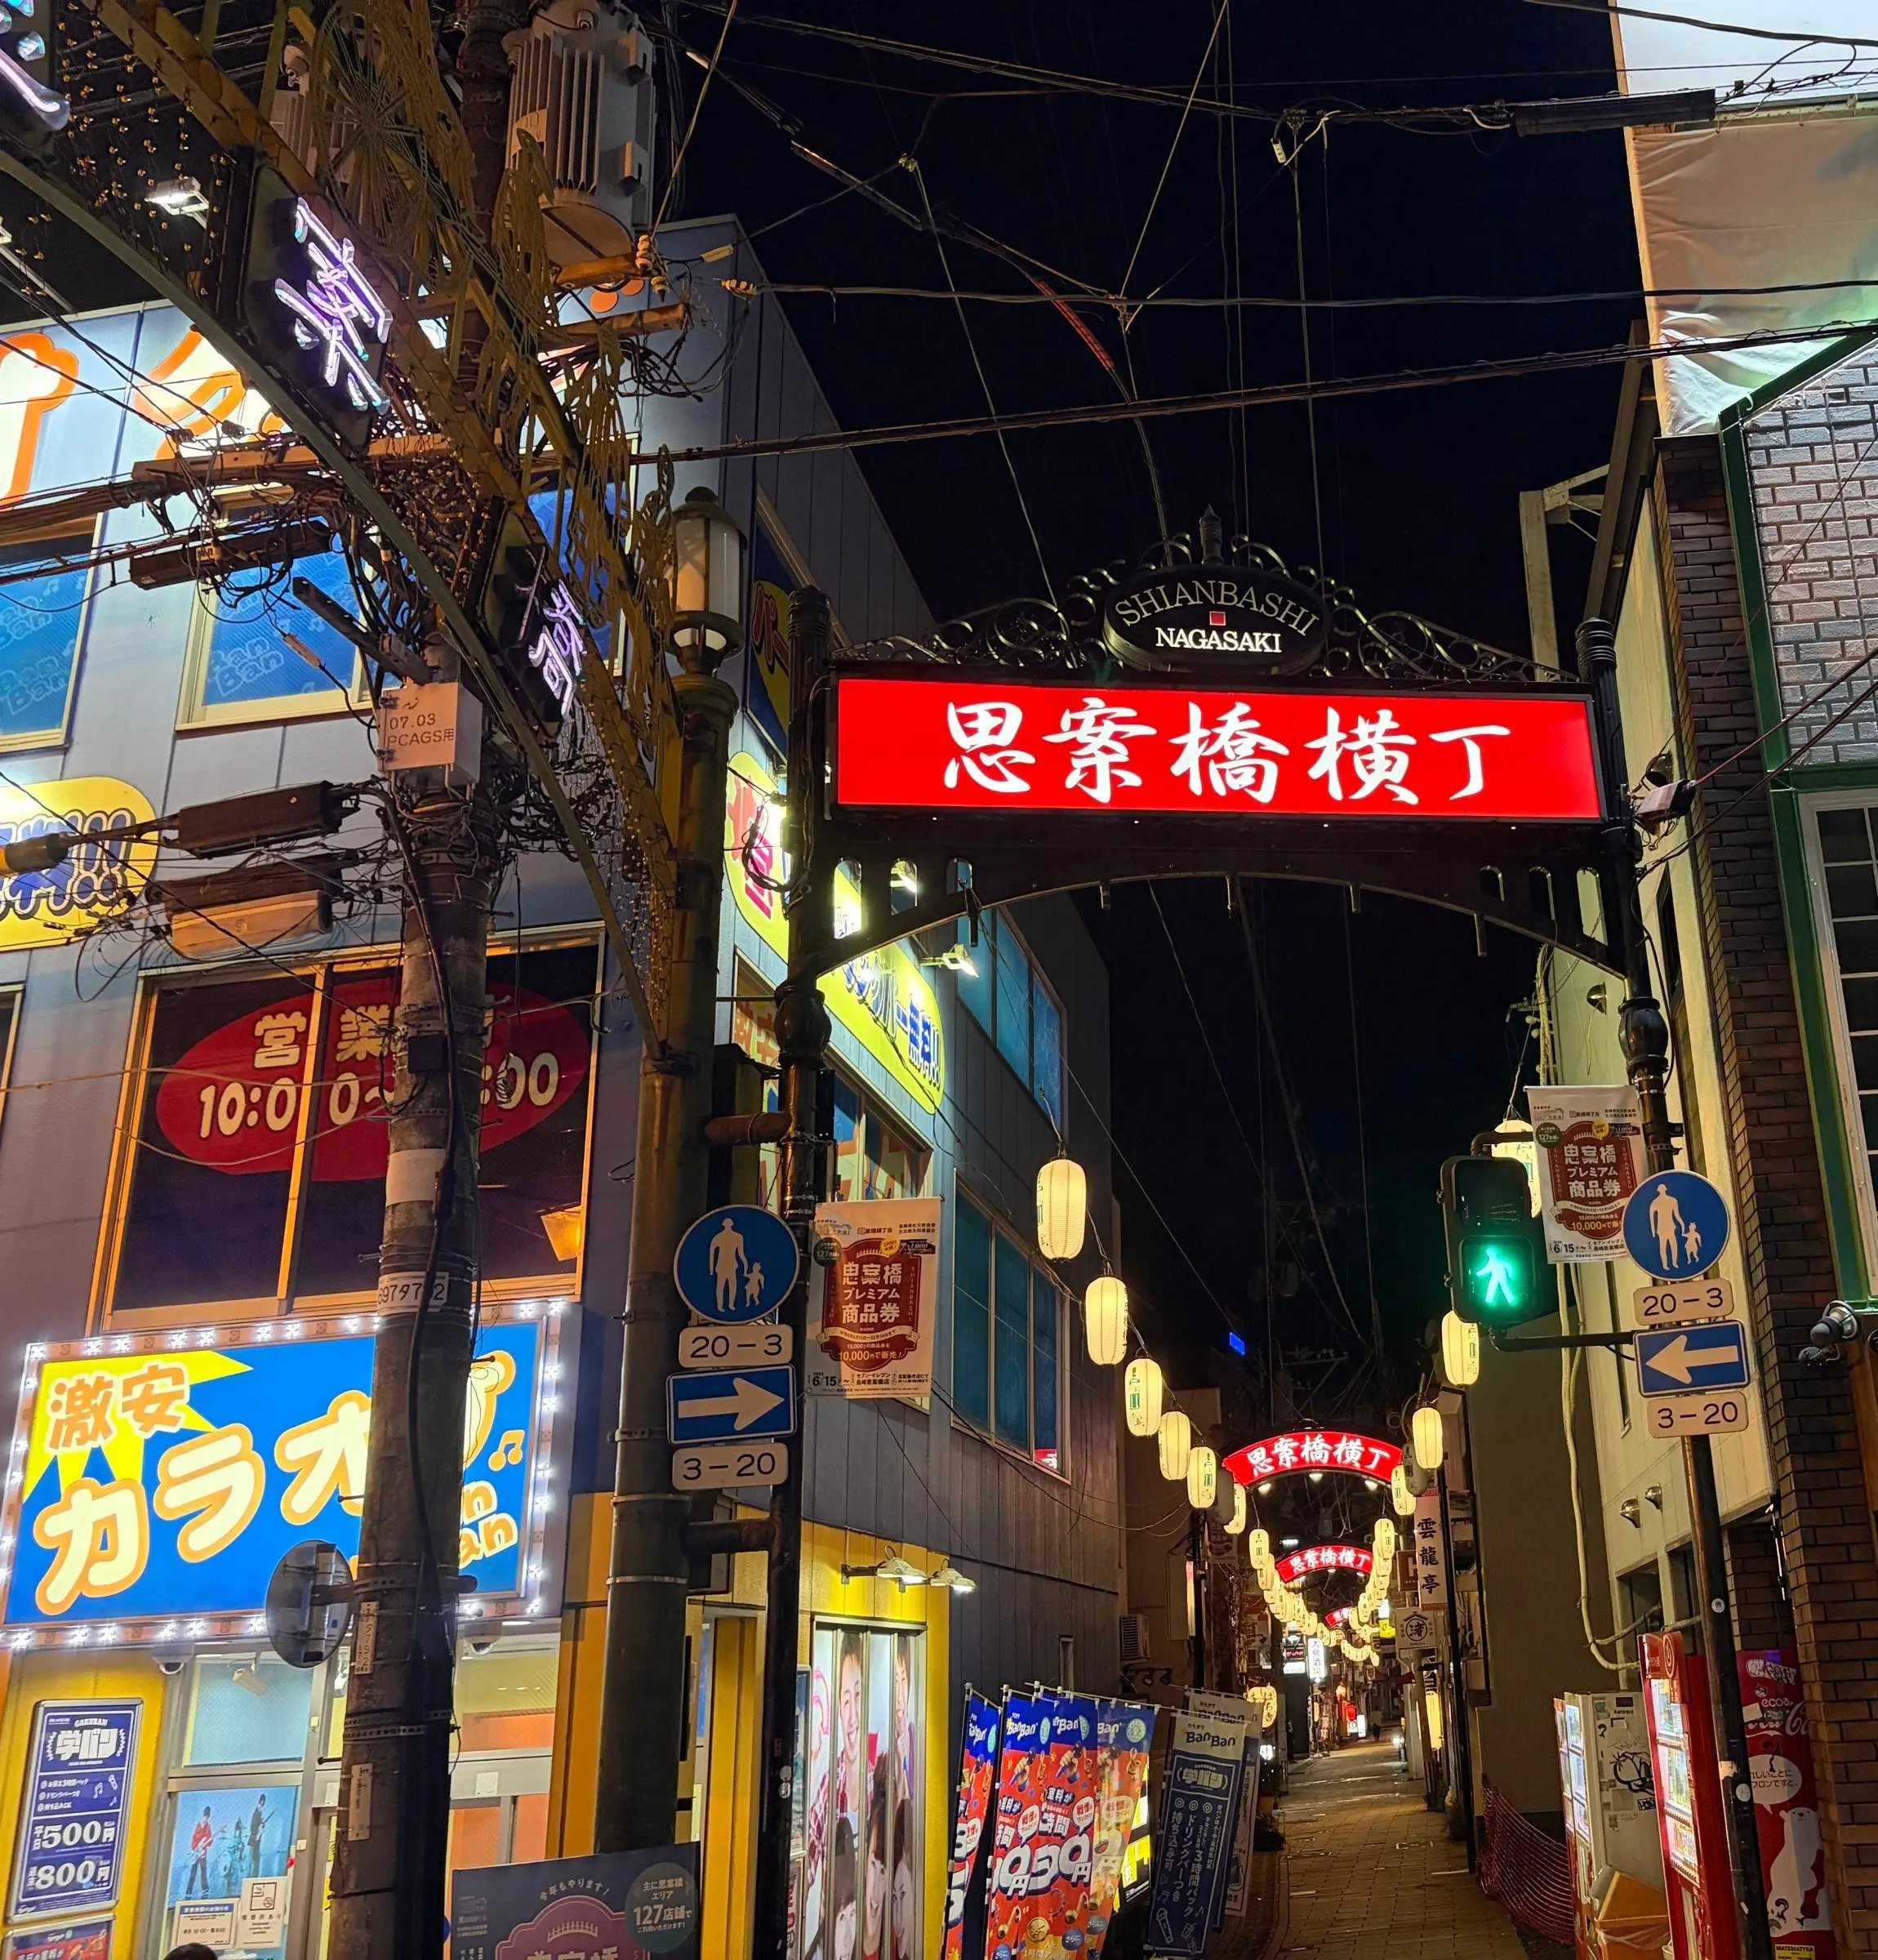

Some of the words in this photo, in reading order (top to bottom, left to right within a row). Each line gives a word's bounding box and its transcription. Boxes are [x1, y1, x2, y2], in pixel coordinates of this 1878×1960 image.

[1115, 579, 1321, 637] SHIANBASHI
[1155, 626, 1282, 653] NAGASAKI
[389, 713, 436, 730] 07.03
[388, 728, 454, 748] PCAGS用
[944, 697, 1511, 804] 思案橋横丁
[1567, 1167, 1618, 1178] プレミアム
[1568, 1179, 1621, 1199] 商品券
[1554, 1244, 1574, 1254] 6/15
[843, 1288, 901, 1300] プレミアム
[842, 1303, 900, 1324] 商品券
[812, 1376, 837, 1386] 6/15
[47, 1362, 190, 1450] 激安
[1246, 1433, 1391, 1477] 思案橋横丁
[1289, 1549, 1372, 1574] 思案橋横丁
[1417, 1517, 1441, 1594] 雲龍亭
[1186, 1731, 1237, 1748] BanBan
[42, 1820, 116, 1849] 500円
[1164, 1810, 1184, 1872] 持ち込み可
[1172, 1814, 1197, 1902] ドリンクバーつき
[35, 1860, 111, 1890] 800円
[1184, 1850, 1204, 1918] 3時間パック
[539, 1878, 612, 1902] 今年もやります!
[652, 1891, 674, 1902] エリア
[633, 1903, 692, 1926] 127店舗で
